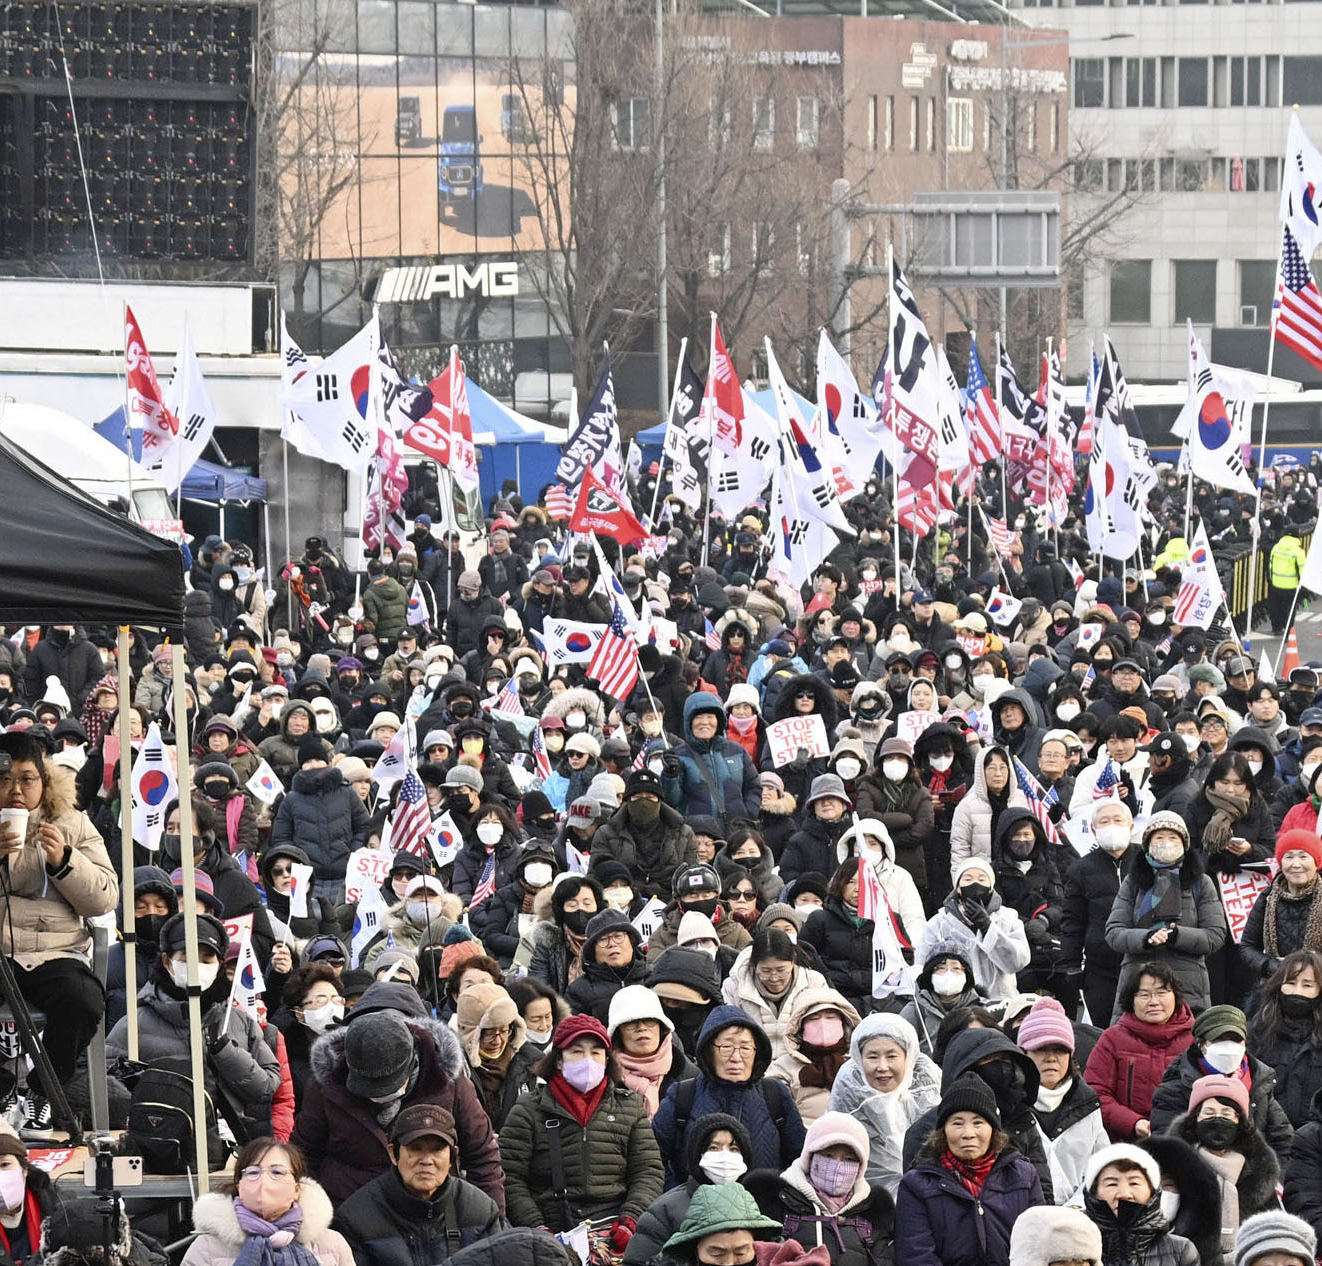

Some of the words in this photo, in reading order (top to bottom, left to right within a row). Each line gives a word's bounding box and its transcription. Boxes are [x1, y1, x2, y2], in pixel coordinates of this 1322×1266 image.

[422, 261, 520, 299] AMG
[773, 719, 815, 738] STOP
[781, 731, 813, 748] THE
